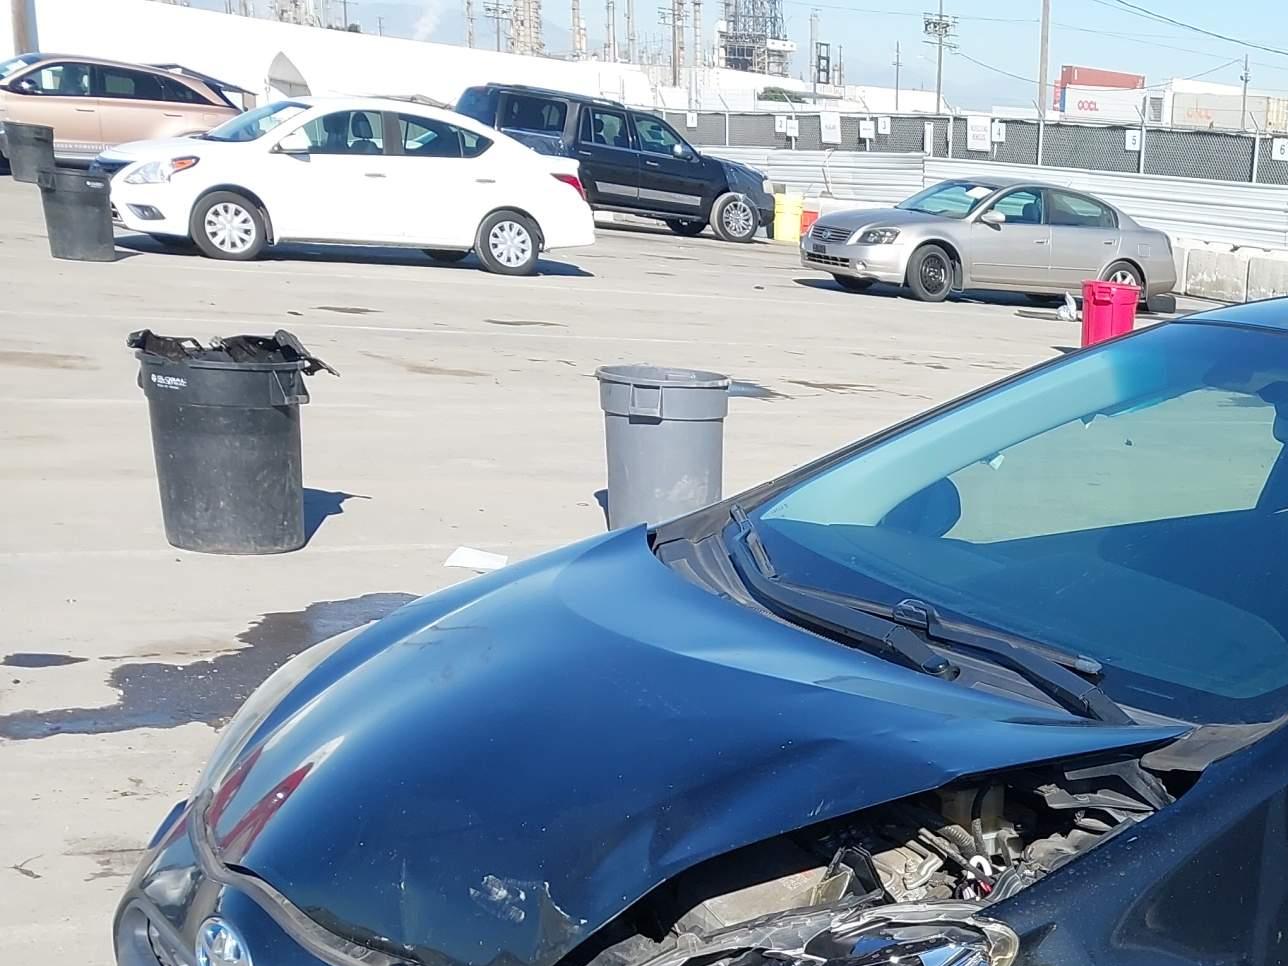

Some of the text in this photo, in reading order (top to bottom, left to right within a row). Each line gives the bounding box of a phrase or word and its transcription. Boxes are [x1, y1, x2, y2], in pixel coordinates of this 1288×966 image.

[1077, 99, 1100, 112] OOCL
[1131, 135, 1138, 146] 5
[1279, 144, 1286, 156] 6
